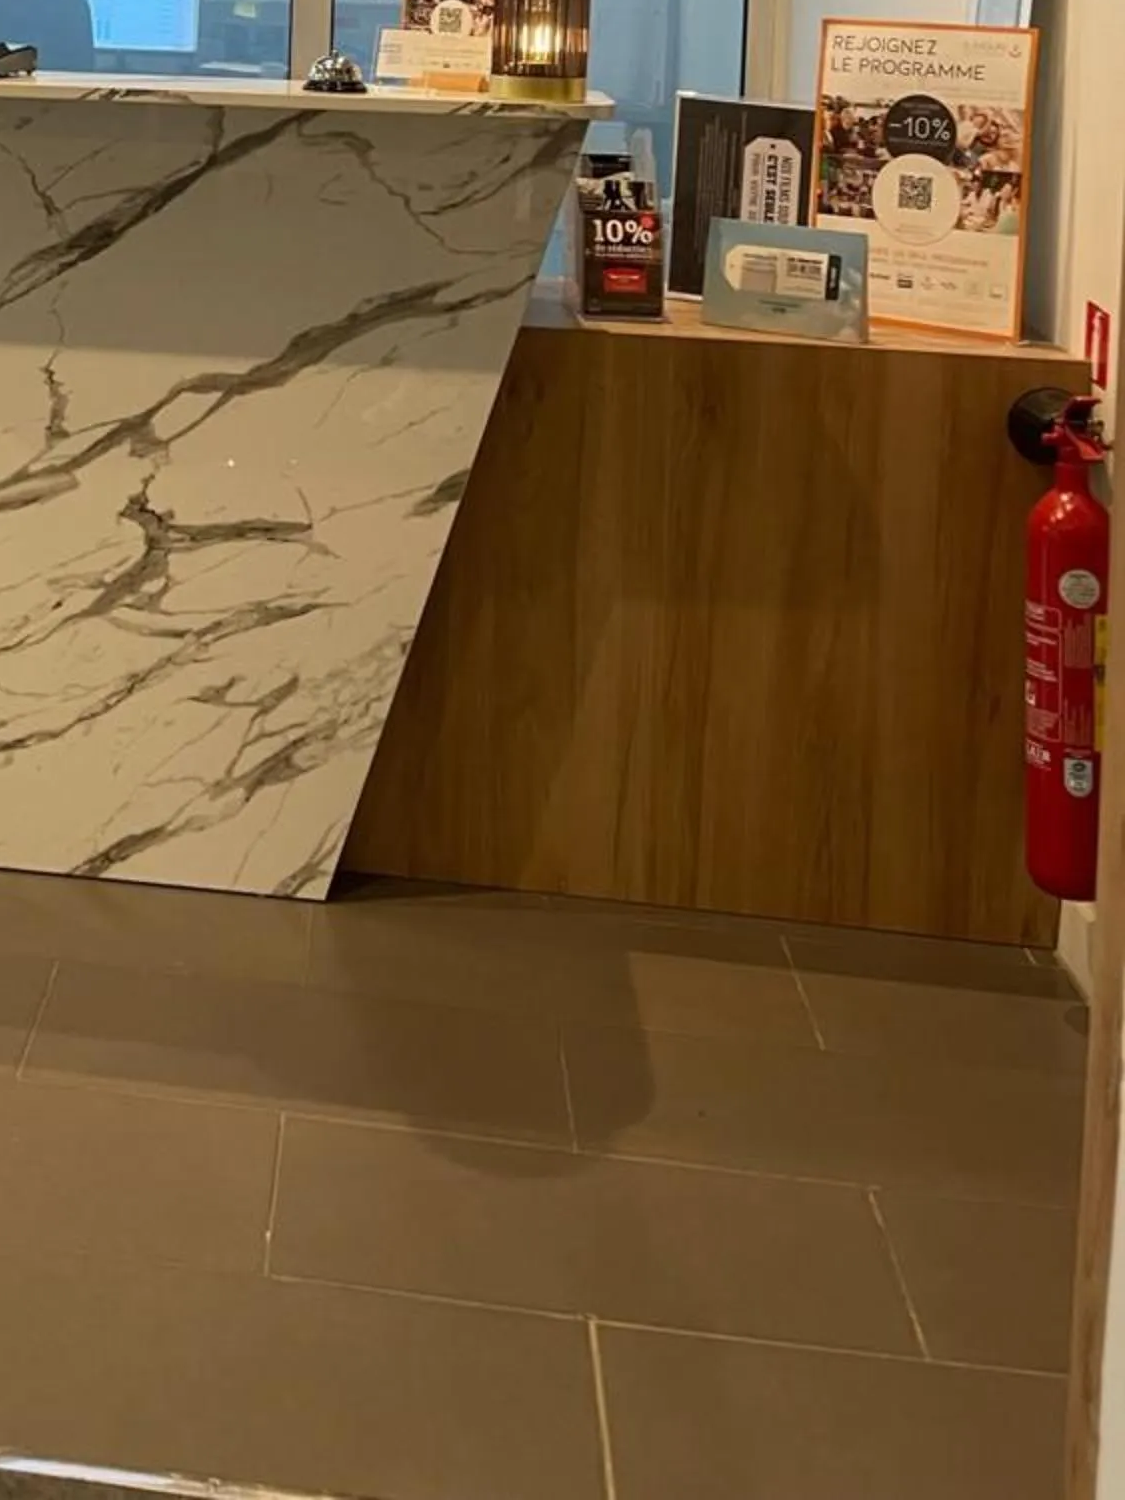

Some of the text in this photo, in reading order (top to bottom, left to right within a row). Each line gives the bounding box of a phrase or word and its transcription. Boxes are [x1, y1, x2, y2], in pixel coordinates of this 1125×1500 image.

[831, 35, 937, 56] REJOIGNEZ
[831, 57, 986, 82] LE PROGRAMME
[888, 116, 951, 141] -10%
[592, 218, 653, 244] 10%
